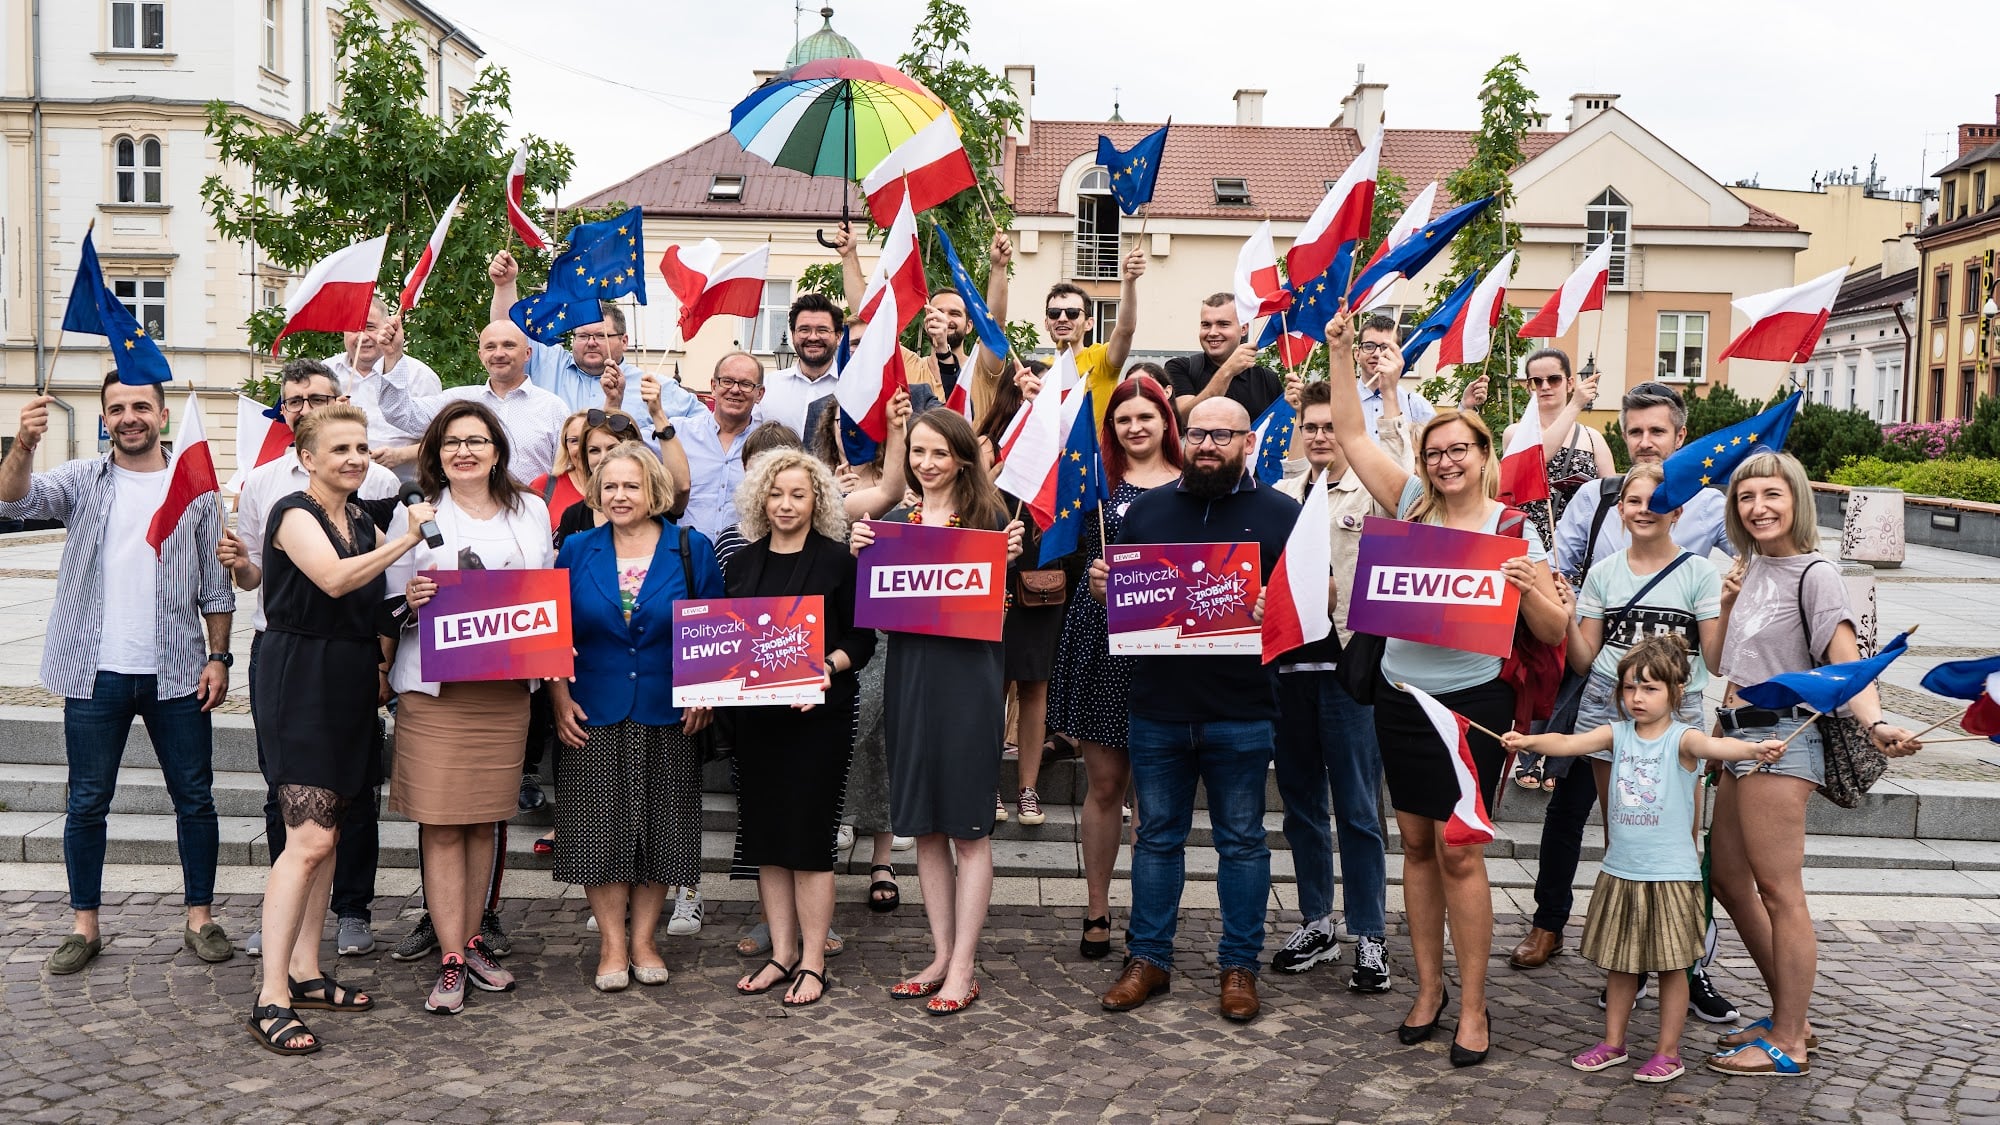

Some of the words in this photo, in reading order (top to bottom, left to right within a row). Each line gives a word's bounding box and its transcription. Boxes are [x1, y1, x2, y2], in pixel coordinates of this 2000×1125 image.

[1115, 553, 1139, 561] LEWICA
[878, 568, 984, 592] LEWICA
[1114, 565, 1179, 587] Polityczki
[1376, 571, 1496, 600] LEWICA
[1116, 587, 1176, 608] LEWICY
[683, 606, 707, 615] LEWICA
[443, 607, 551, 643] LEWICA
[681, 619, 745, 640] Polityczki
[682, 639, 742, 660] LEWICY
[1620, 813, 1659, 826] UNICORN
